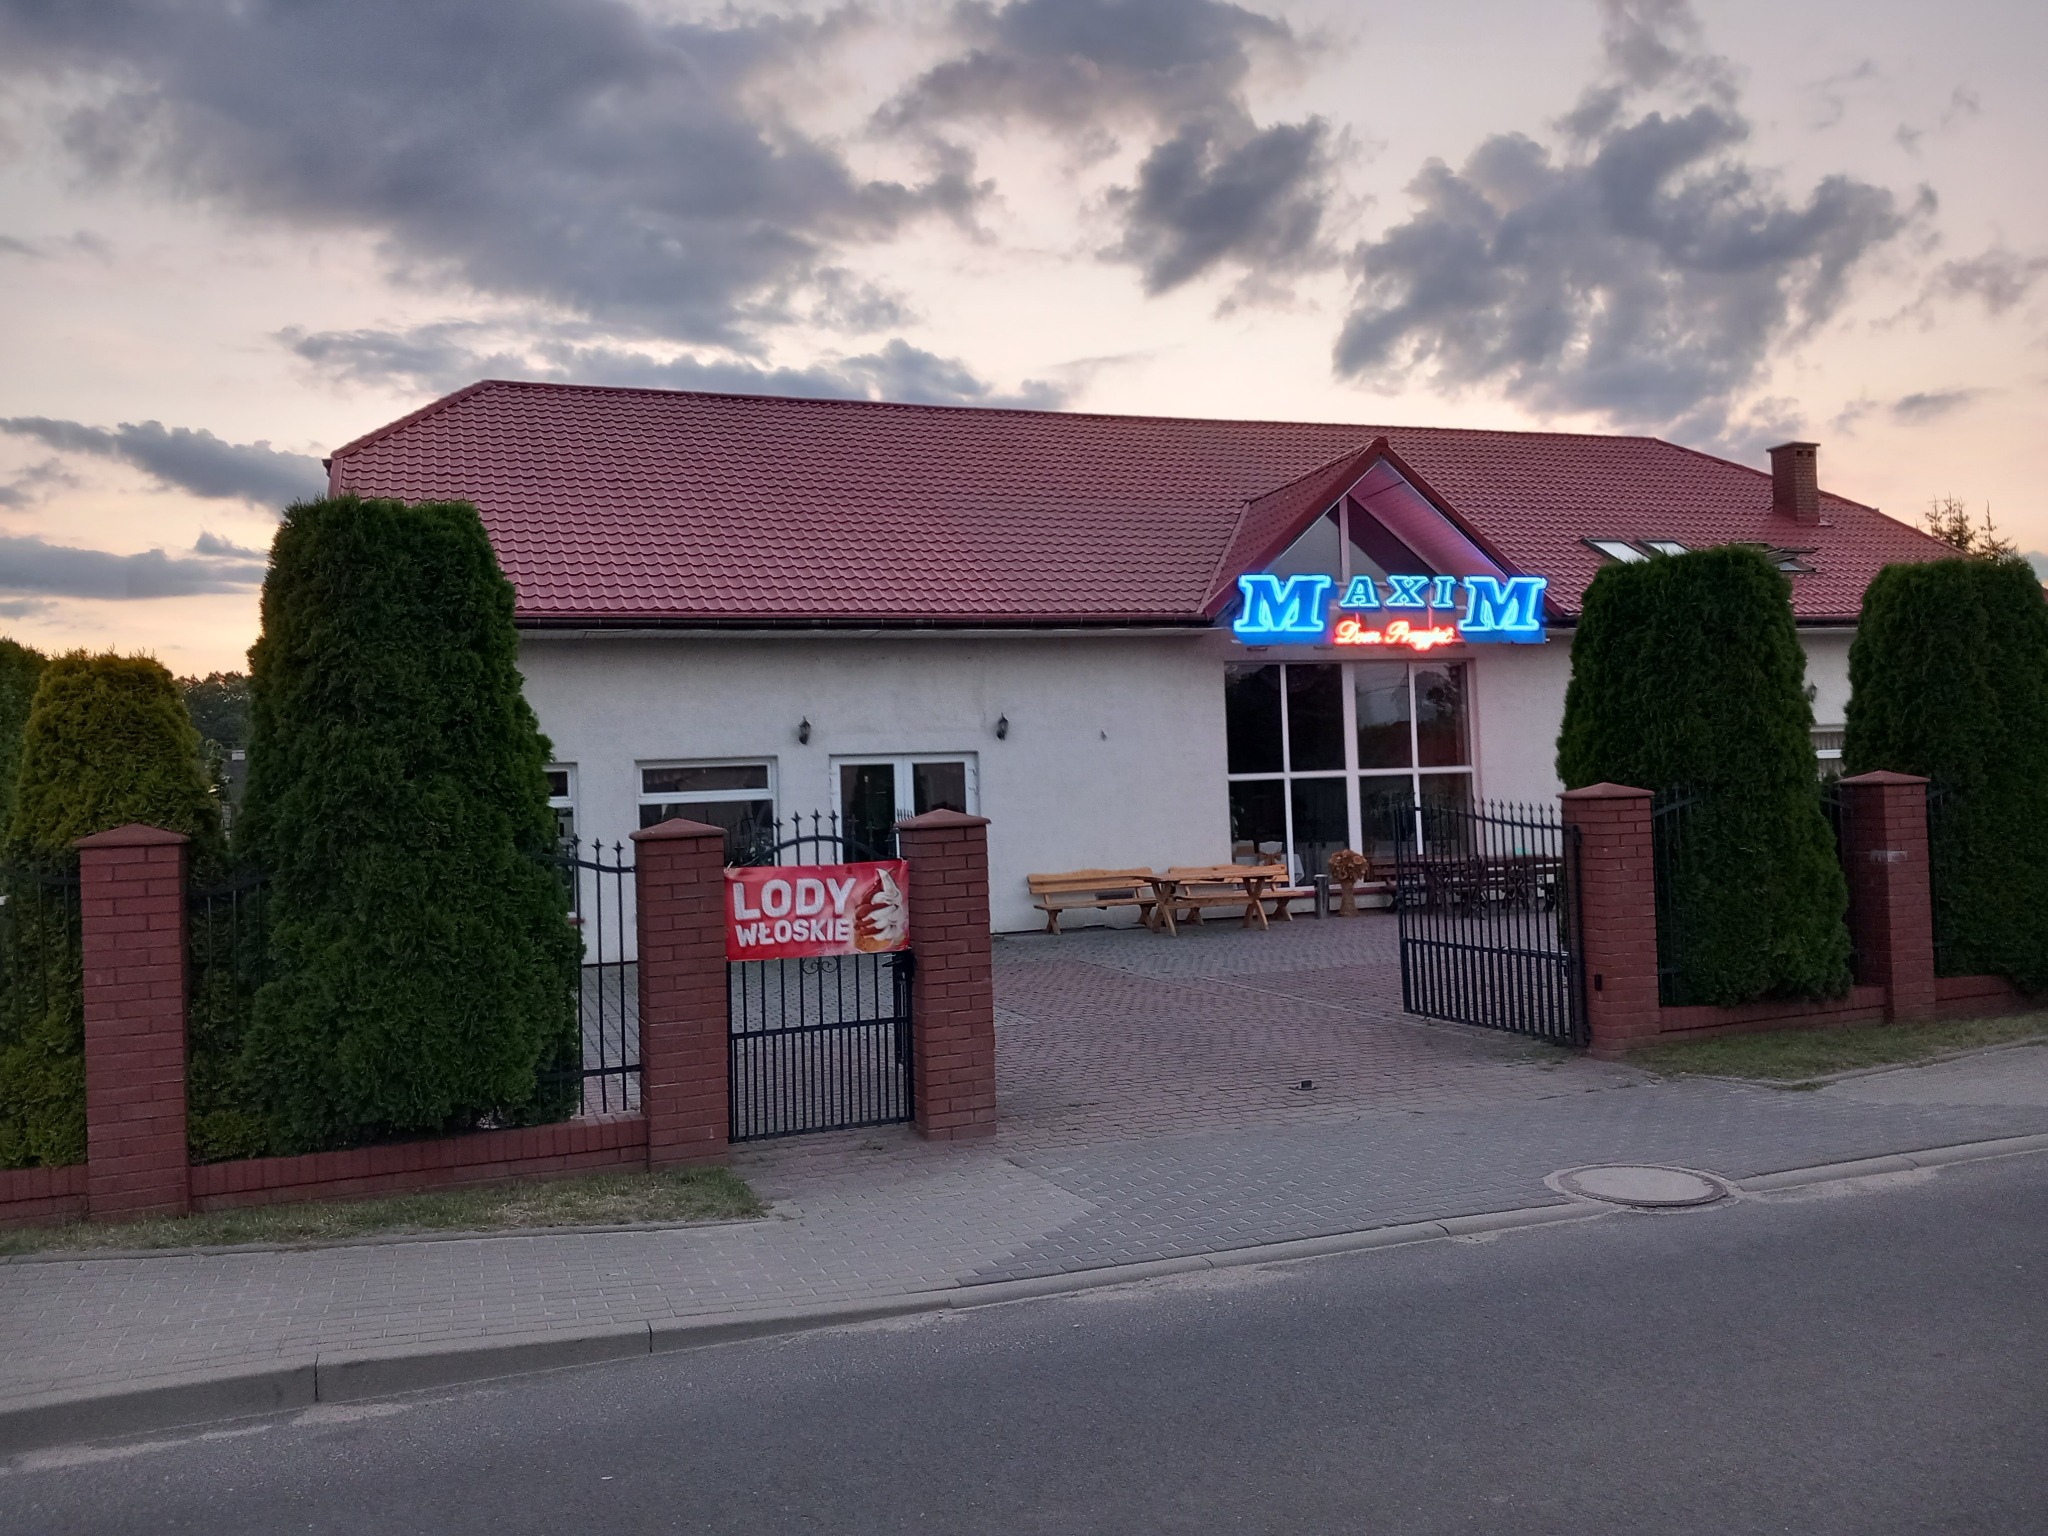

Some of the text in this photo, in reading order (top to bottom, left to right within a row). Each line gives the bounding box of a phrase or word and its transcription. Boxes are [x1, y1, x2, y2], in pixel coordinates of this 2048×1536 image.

[1233, 574, 1547, 632] MAXIM
[1336, 620, 1382, 643] Dom
[732, 878, 857, 921] LODY
[735, 918, 850, 948] WŁOSKIE
